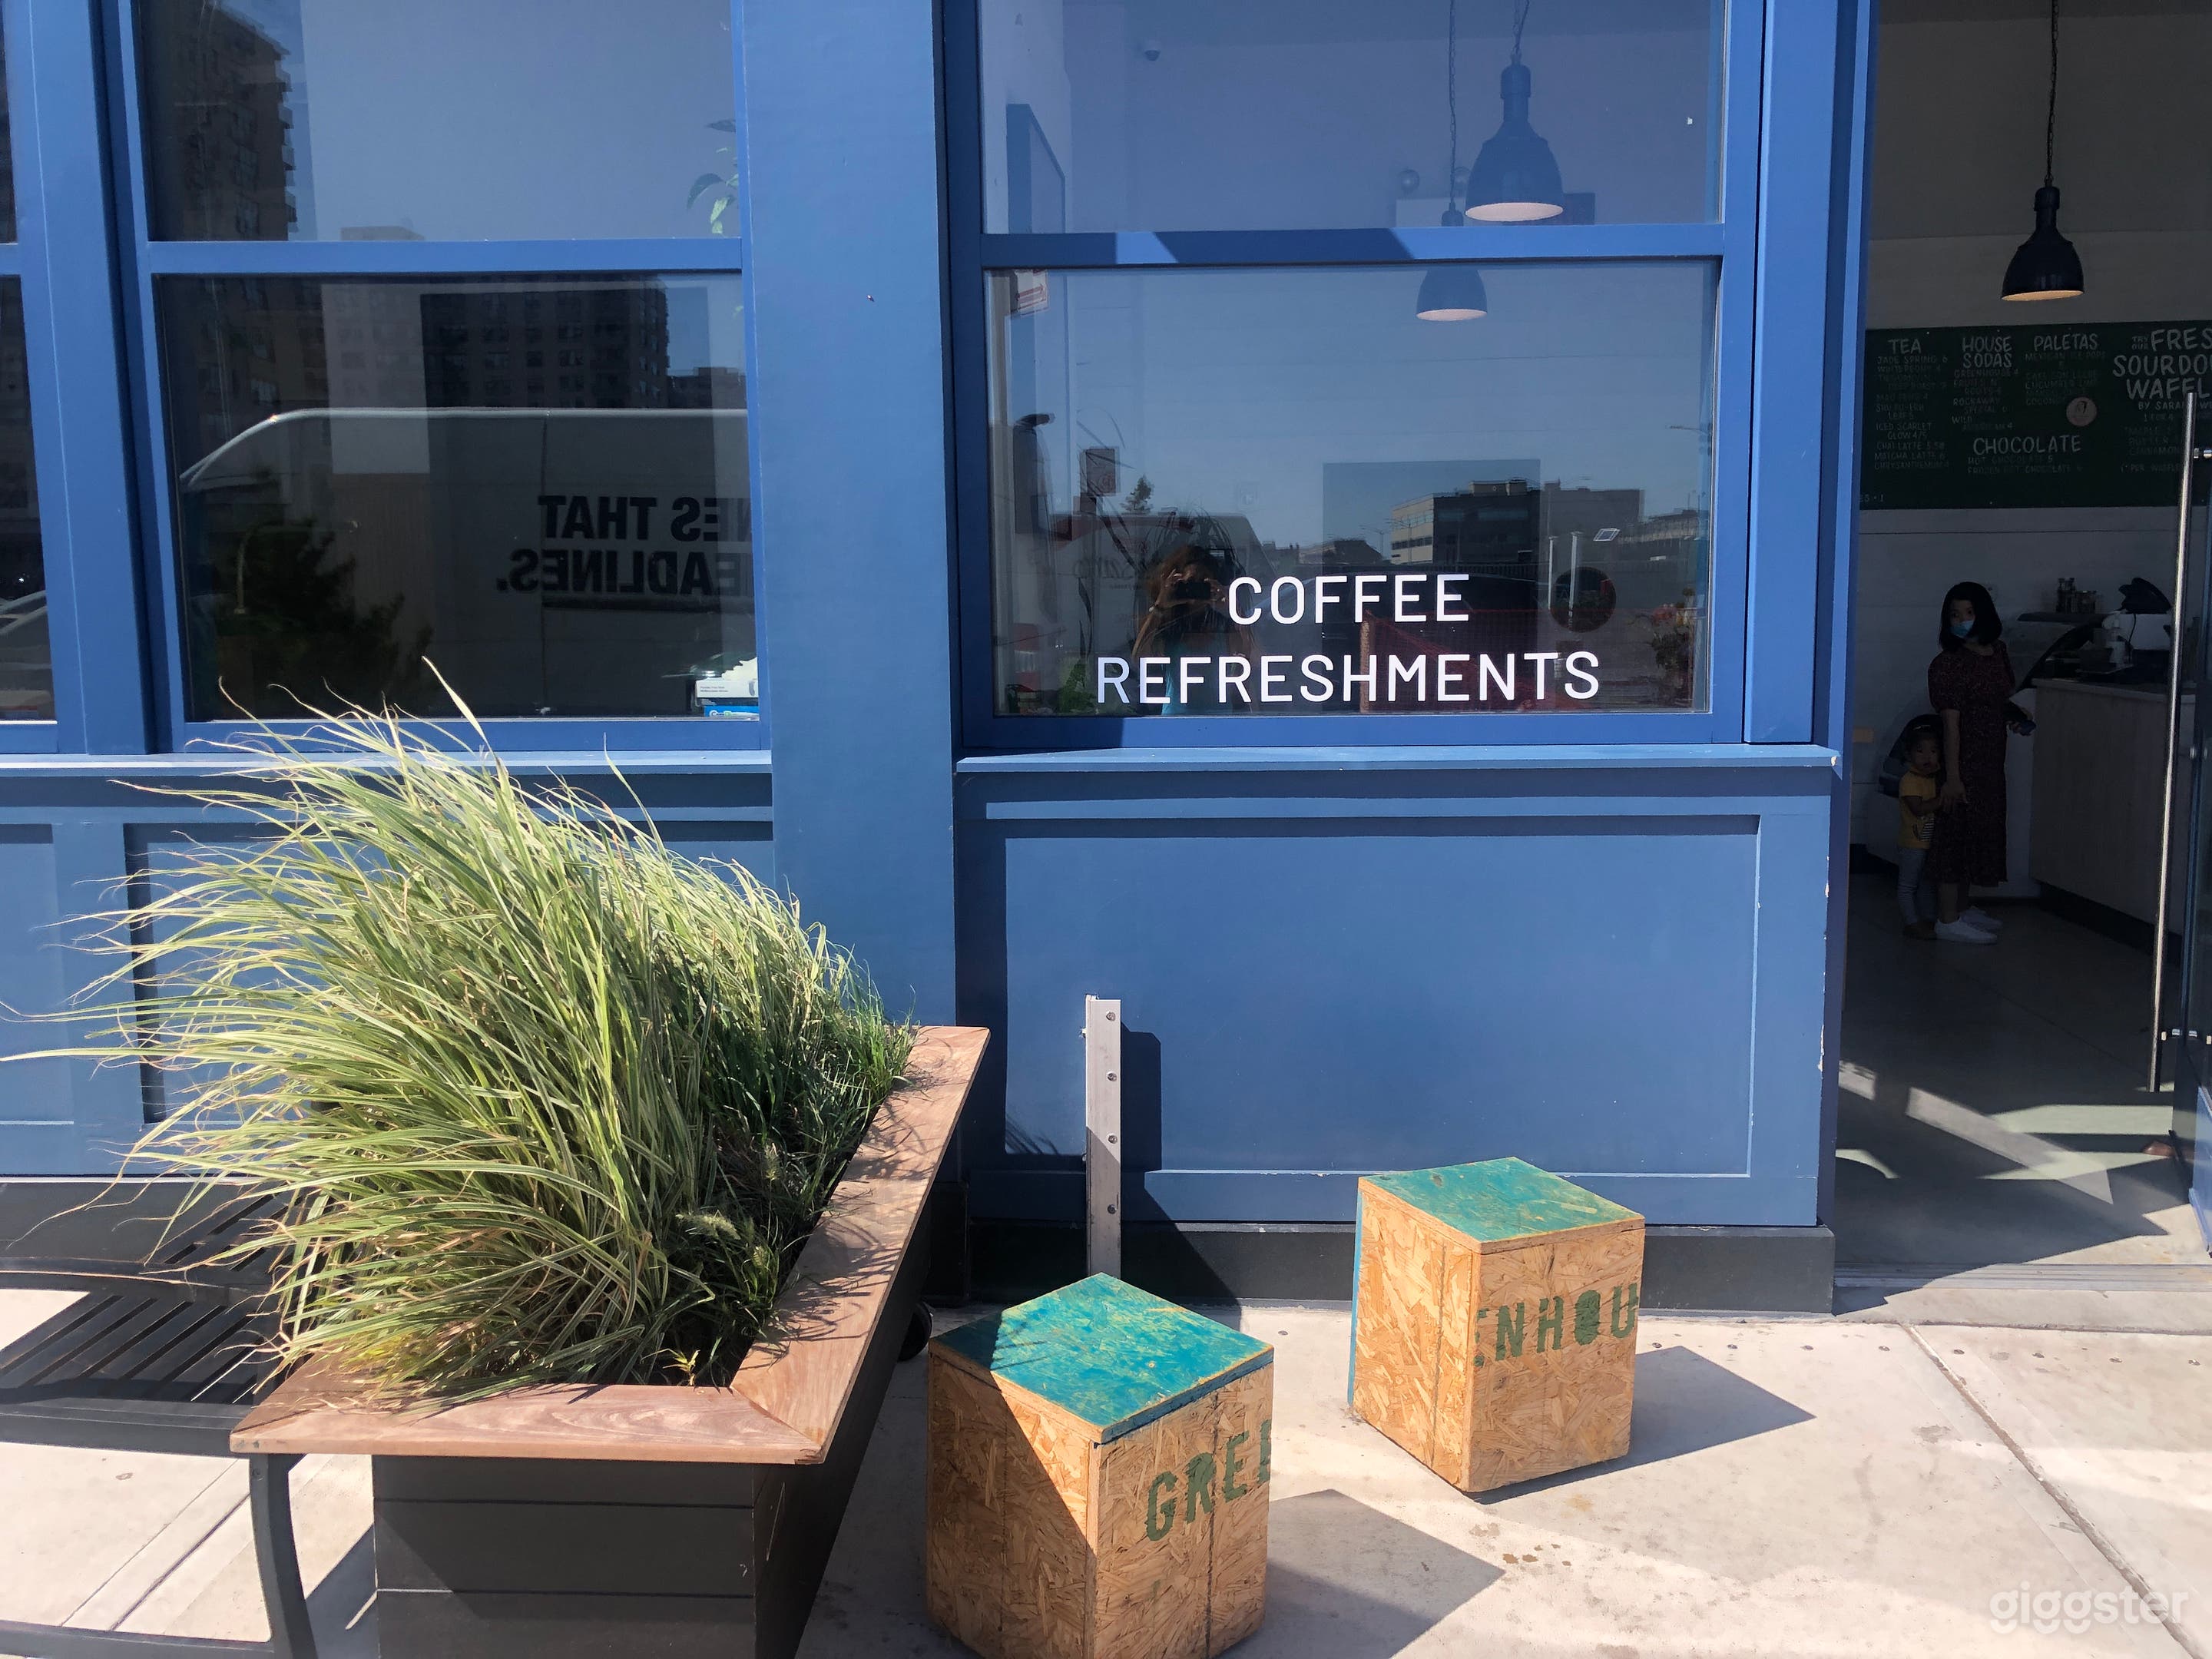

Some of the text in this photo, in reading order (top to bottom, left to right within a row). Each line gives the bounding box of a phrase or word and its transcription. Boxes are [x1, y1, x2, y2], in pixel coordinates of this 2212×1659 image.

[1887, 338, 1922, 355] TEA
[1962, 336, 2012, 353] HOUSE
[2034, 333, 2098, 351] PALETAS
[1962, 353, 2012, 368] SODAS
[2138, 401, 2151, 410] BY
[1973, 434, 2082, 455] CHOCOLATE
[1227, 573, 1470, 625] COFFEE
[1097, 651, 1600, 704] REFRESHMENTS
